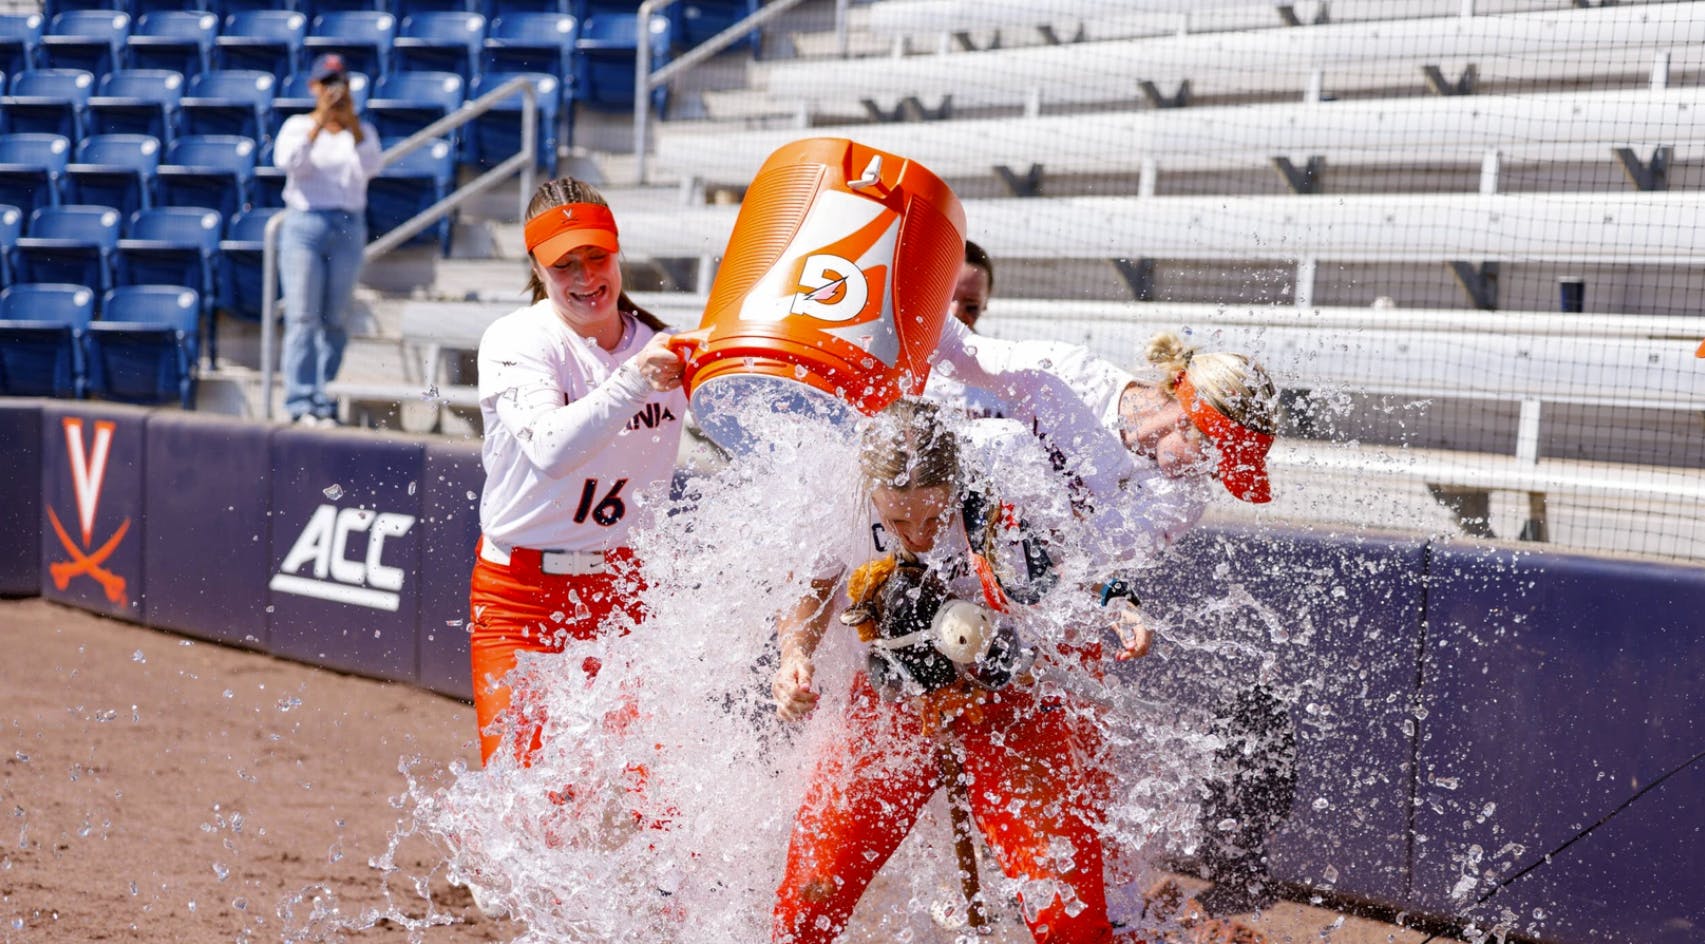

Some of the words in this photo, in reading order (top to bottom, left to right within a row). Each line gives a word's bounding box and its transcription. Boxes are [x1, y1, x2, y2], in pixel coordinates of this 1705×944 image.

[790, 254, 868, 322] G
[62, 417, 117, 549] V
[573, 478, 628, 527] 16
[280, 503, 416, 591] ACC
